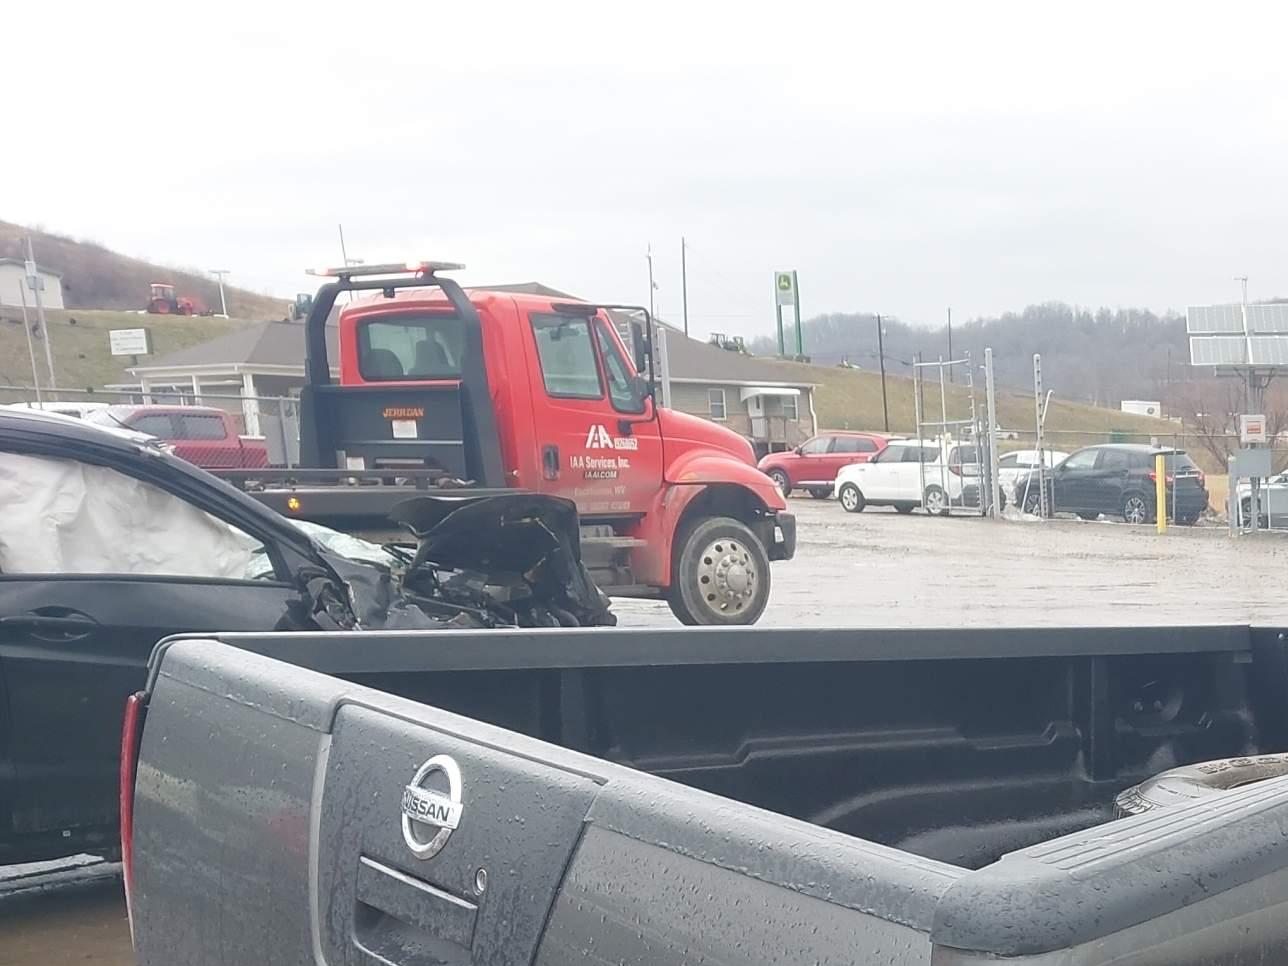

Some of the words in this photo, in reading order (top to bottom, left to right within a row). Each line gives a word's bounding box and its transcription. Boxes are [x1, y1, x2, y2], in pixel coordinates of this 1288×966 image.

[570, 456, 584, 468] IAA
[586, 456, 617, 469] Services,
[618, 456, 630, 468] Inc.
[402, 791, 450, 821] NISSAN
